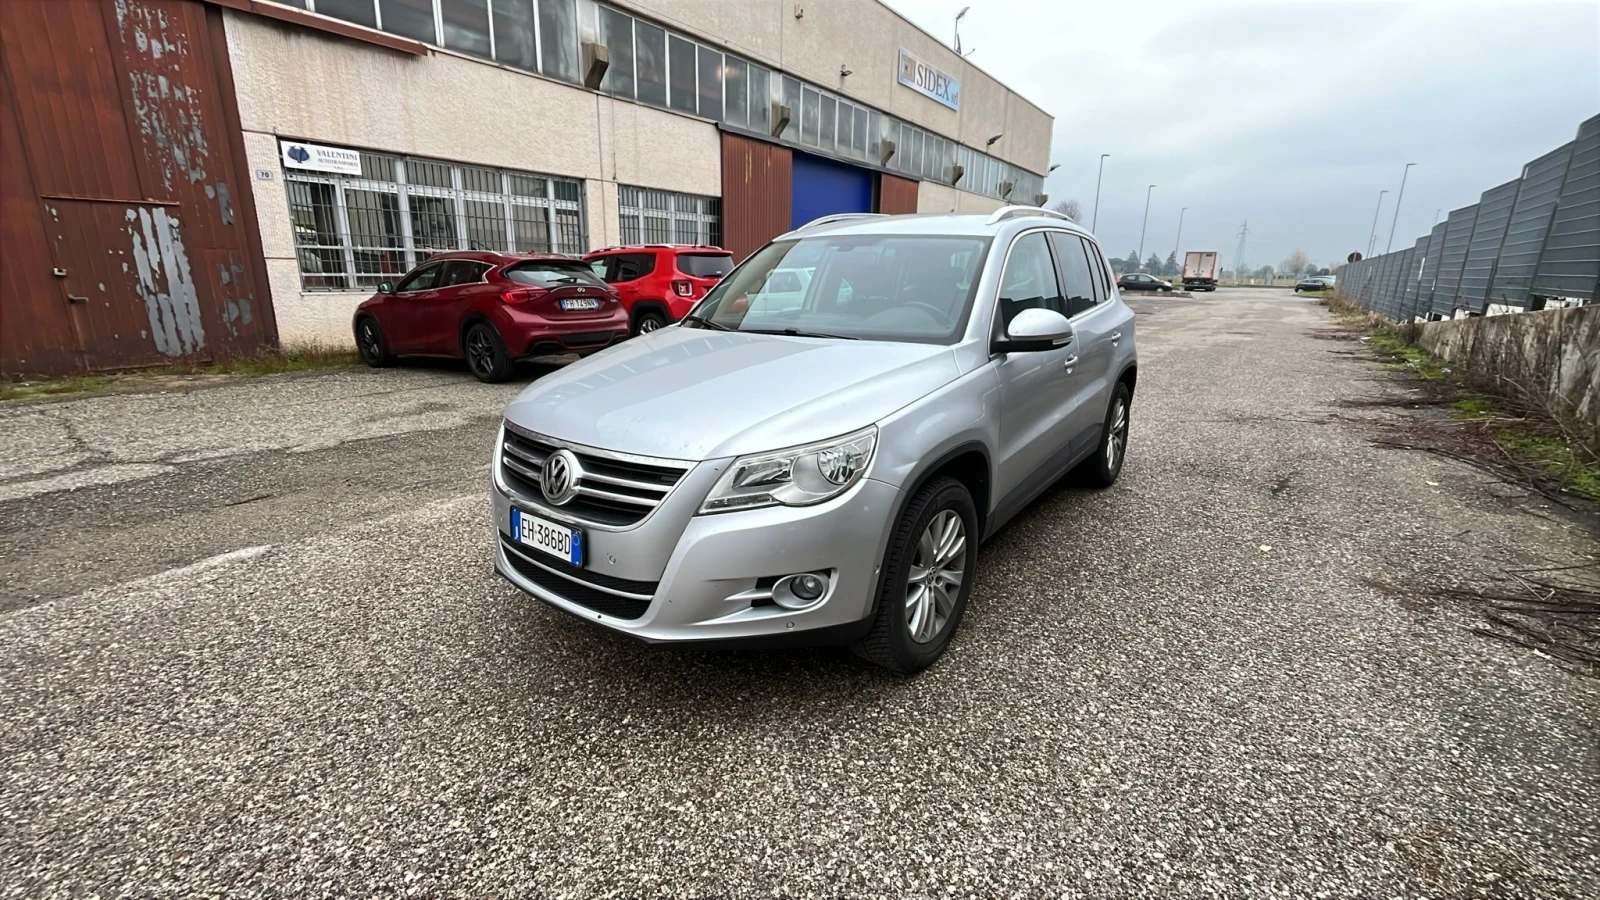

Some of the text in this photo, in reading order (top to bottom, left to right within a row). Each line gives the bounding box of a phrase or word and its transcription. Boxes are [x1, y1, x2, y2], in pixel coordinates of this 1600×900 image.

[917, 64, 959, 105] SIDEX srl
[316, 149, 358, 161] VALENTINI
